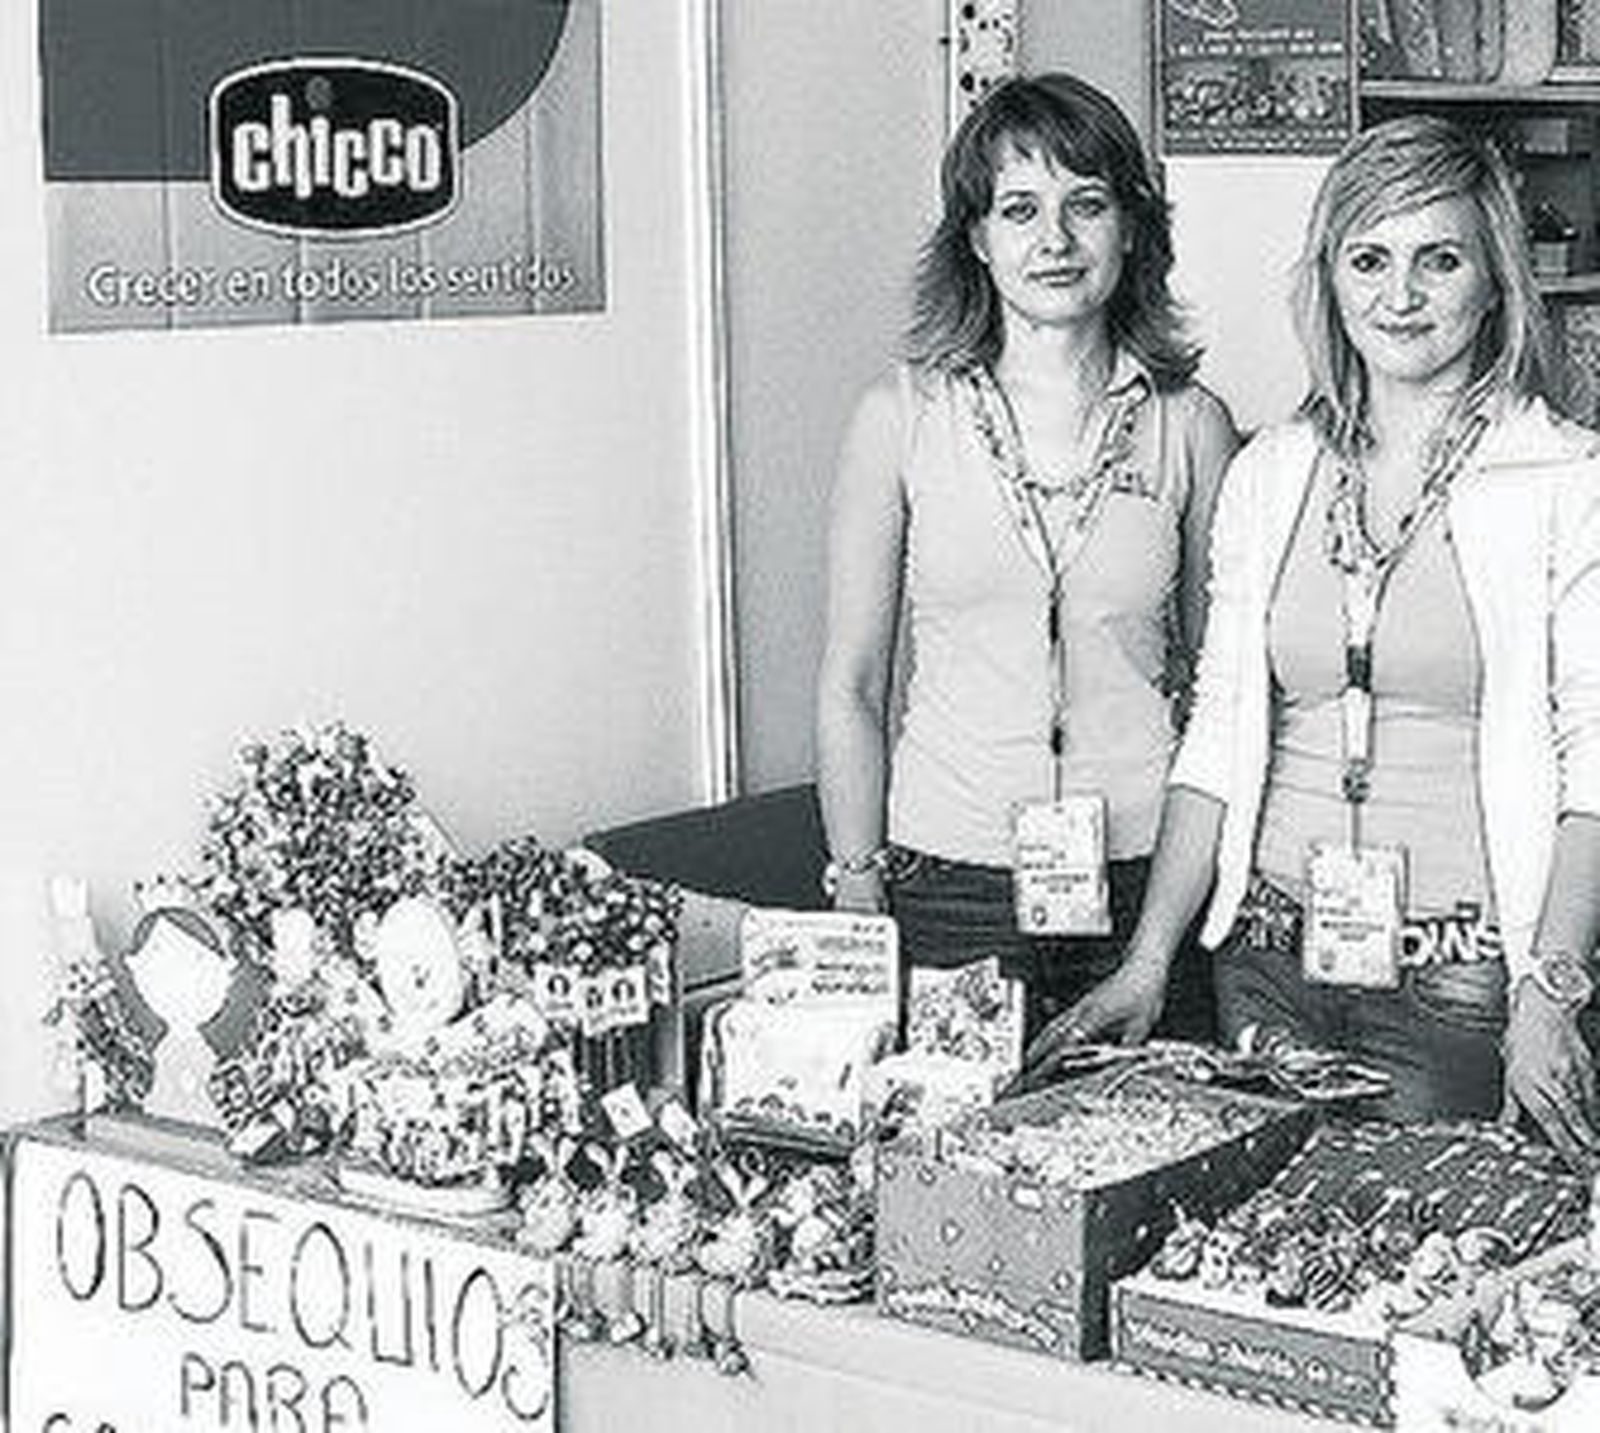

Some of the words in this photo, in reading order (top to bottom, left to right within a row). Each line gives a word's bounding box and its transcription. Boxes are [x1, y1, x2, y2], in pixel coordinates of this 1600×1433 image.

[232, 75, 442, 200] chicco
[88, 264, 216, 303] Crecer
[227, 269, 270, 298] en
[282, 256, 381, 299] todos
[389, 256, 438, 294] los
[446, 252, 575, 293] sentidos
[56, 1169, 553, 1422] OBSEQUIOS
[179, 1351, 370, 1433] PARA
